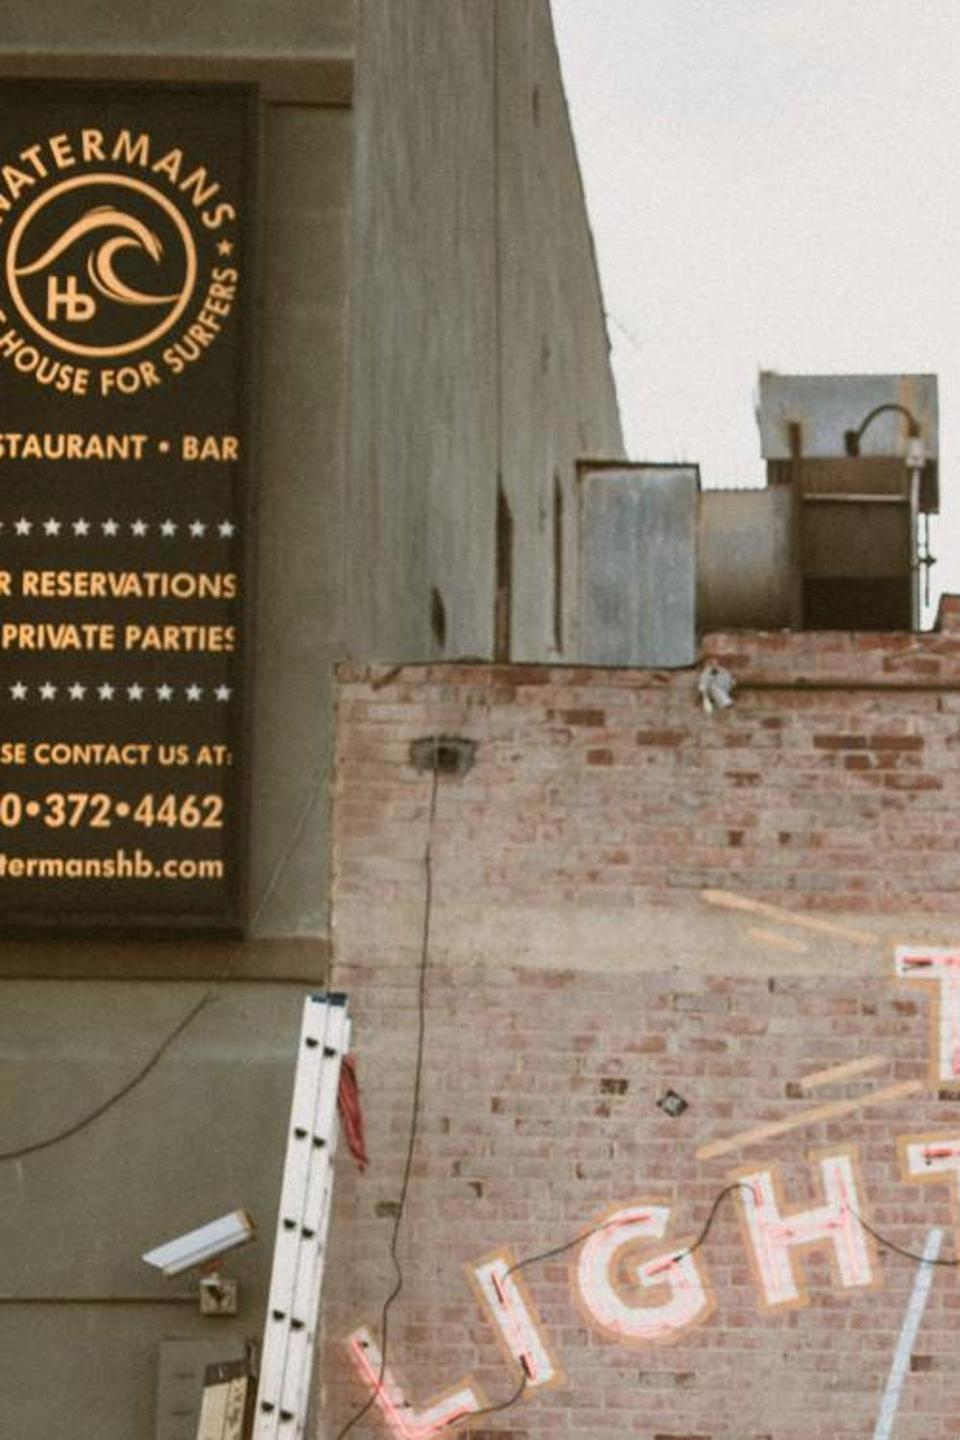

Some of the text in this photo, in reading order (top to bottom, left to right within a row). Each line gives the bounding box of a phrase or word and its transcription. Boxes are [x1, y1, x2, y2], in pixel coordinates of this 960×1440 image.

[0, 267, 238, 396] HOUSE FOR SURFERS
[182, 434, 239, 461] BAR
[22, 570, 237, 599] RESERVATIONS
[2, 623, 235, 652] PRIVATE PARTIES
[34, 743, 151, 766] CONTACT
[158, 744, 189, 766] US
